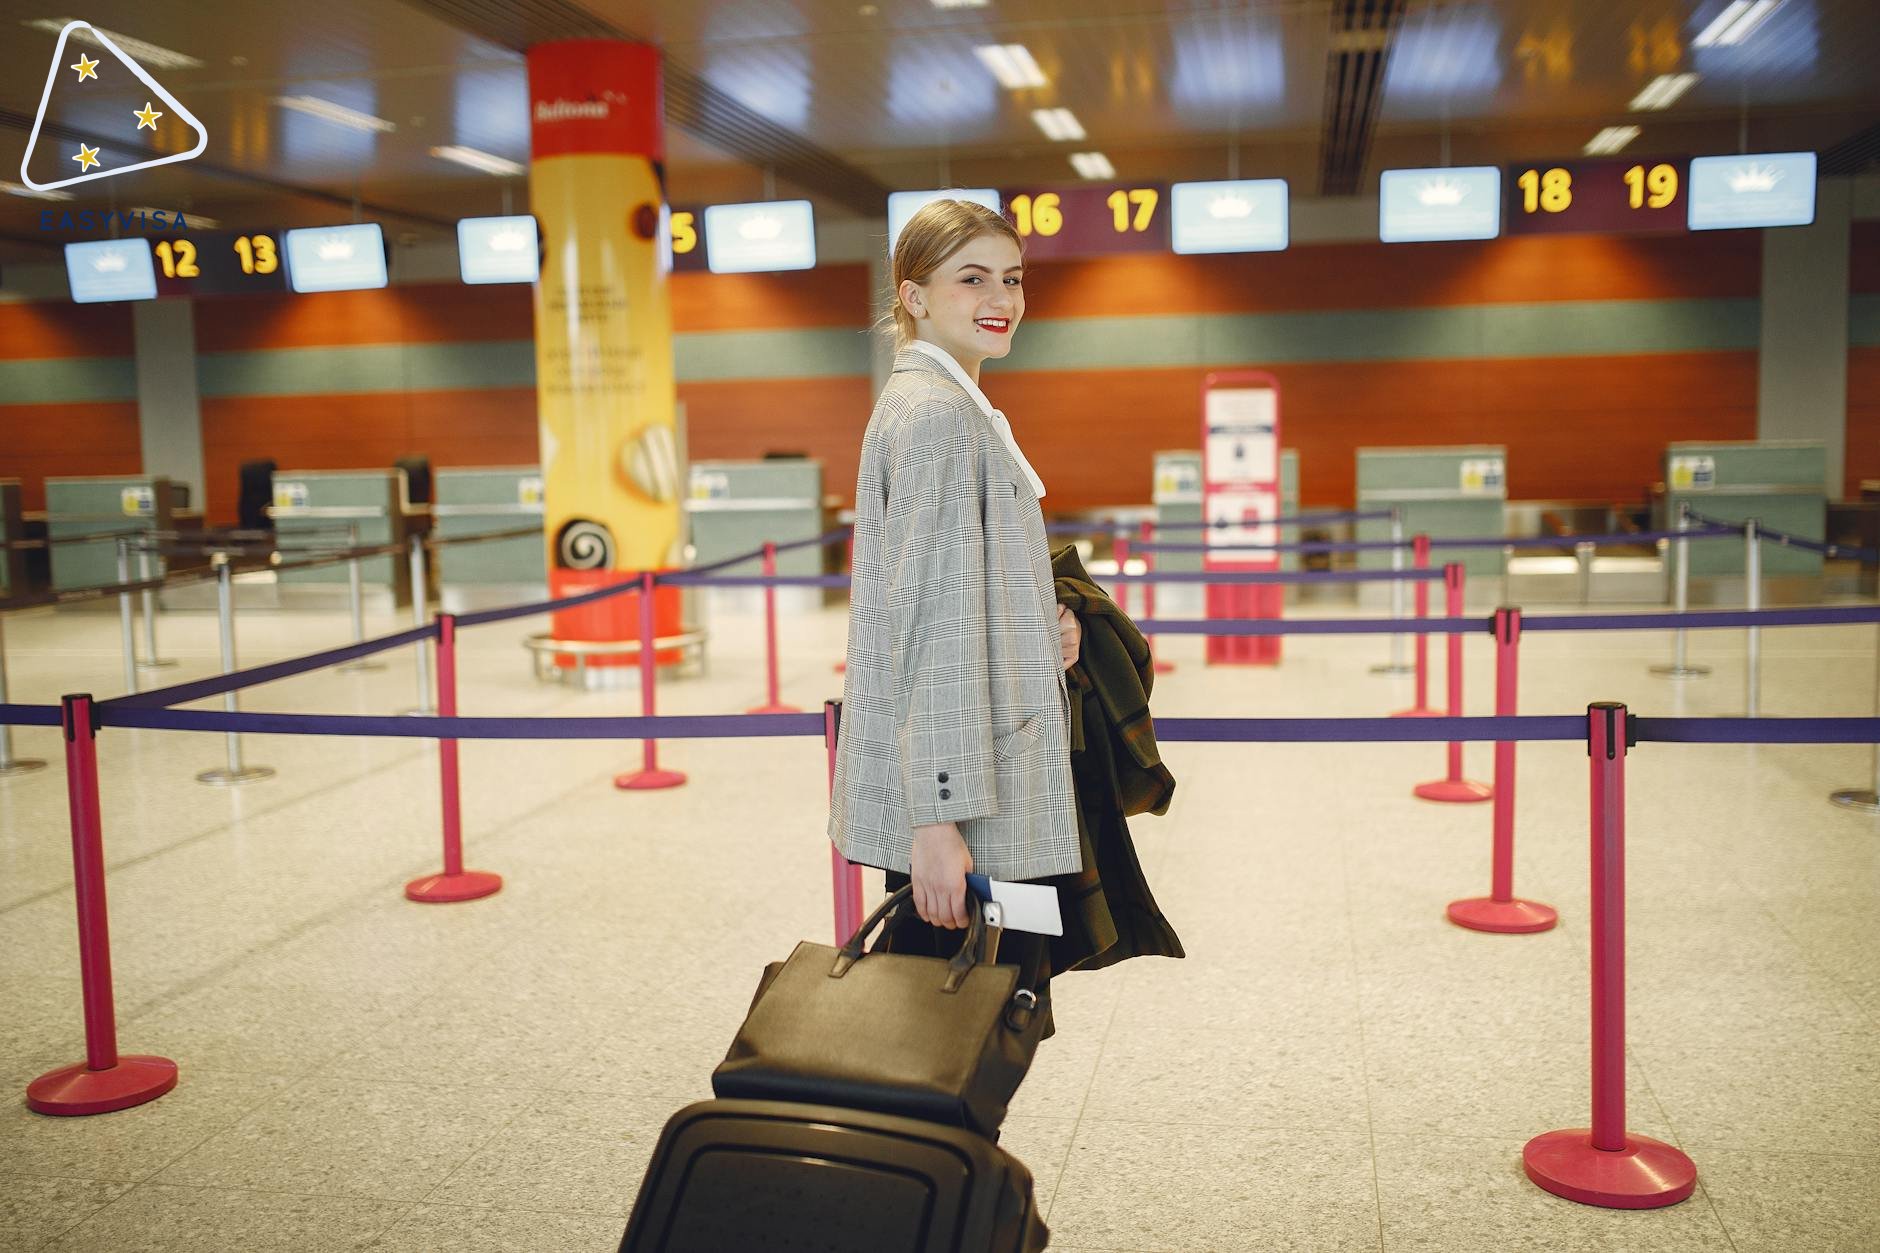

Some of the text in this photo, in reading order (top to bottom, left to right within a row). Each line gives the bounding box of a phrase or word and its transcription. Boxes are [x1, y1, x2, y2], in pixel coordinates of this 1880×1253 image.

[1517, 167, 1573, 213] 18
[1623, 163, 1679, 209] 19
[670, 212, 697, 254] 5
[1009, 192, 1063, 237] 16
[1106, 188, 1159, 233] 17
[155, 239, 200, 278] 12
[233, 234, 279, 274] 13
